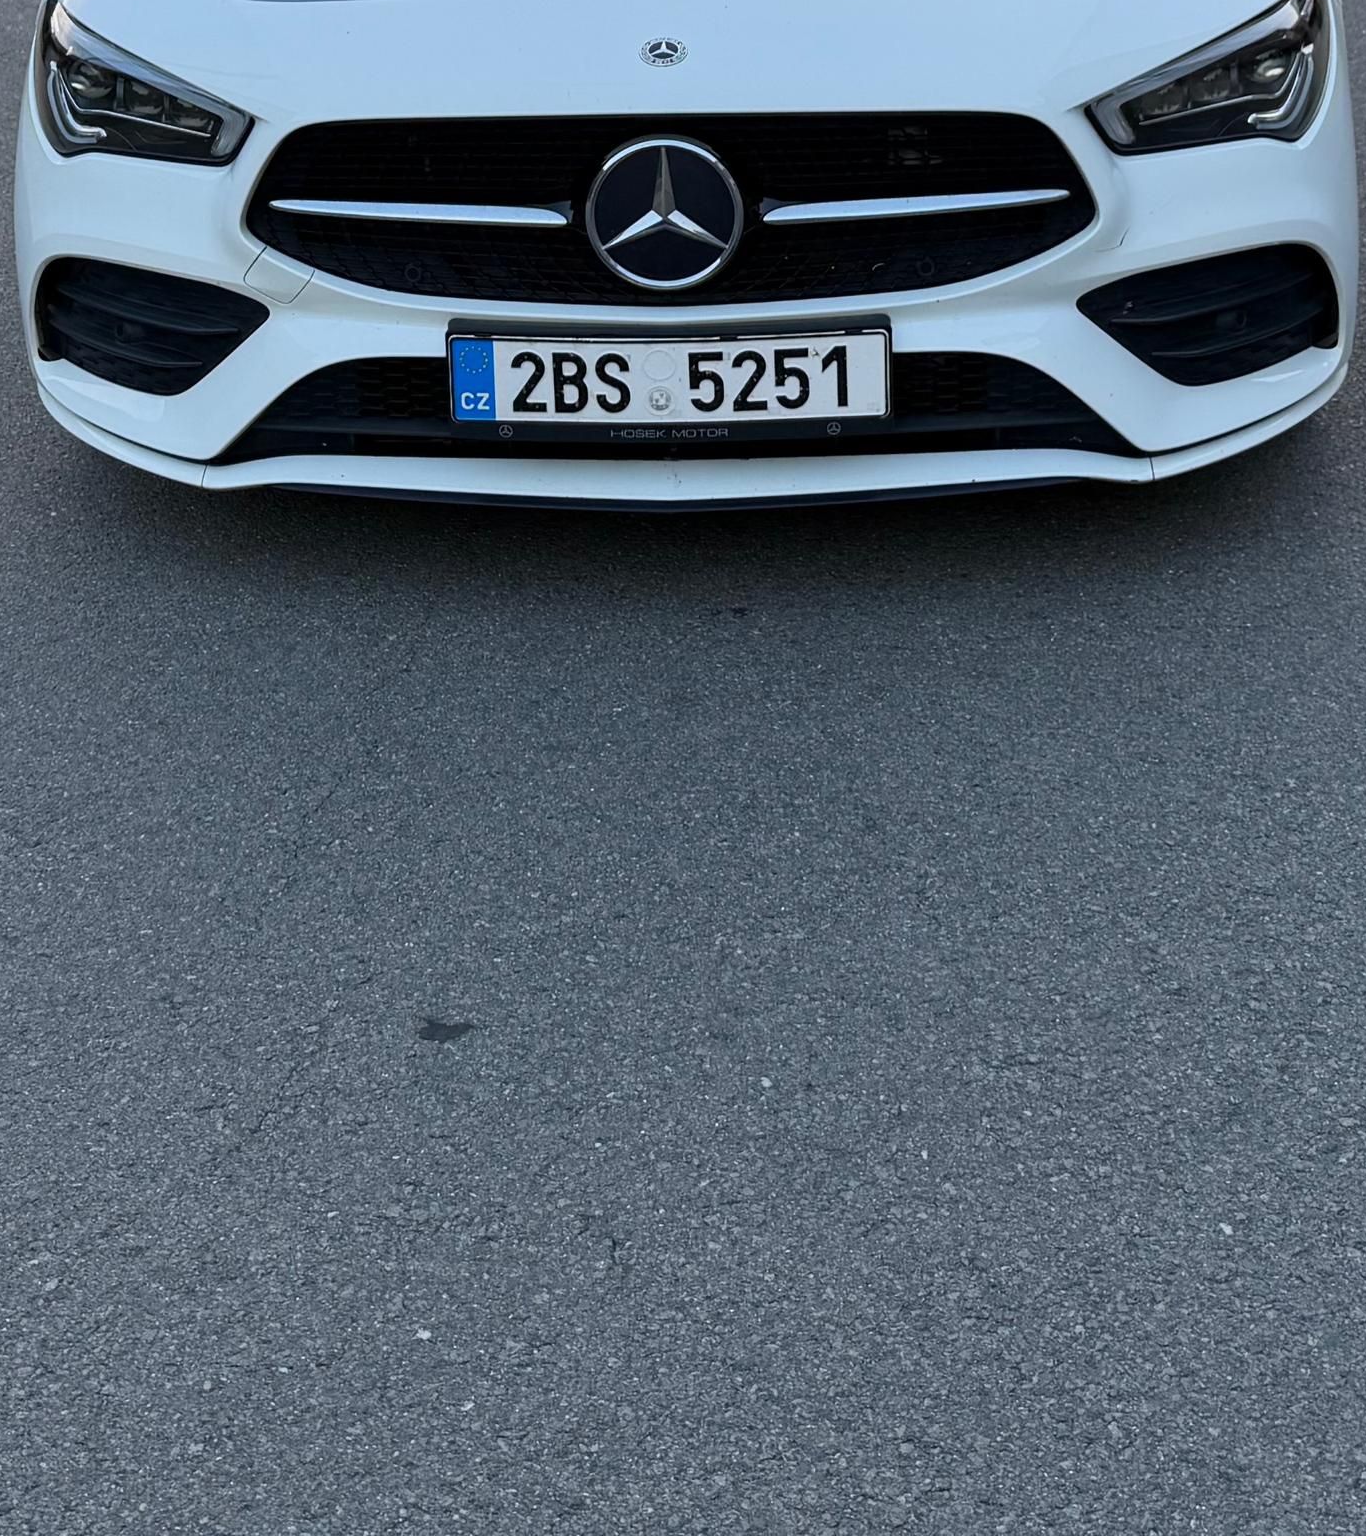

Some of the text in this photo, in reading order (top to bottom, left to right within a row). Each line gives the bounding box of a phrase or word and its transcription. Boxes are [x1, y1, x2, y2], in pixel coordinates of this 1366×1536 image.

[510, 345, 848, 414] 2BS 5251
[460, 392, 490, 411] CZ
[671, 428, 729, 439] MOTOR
